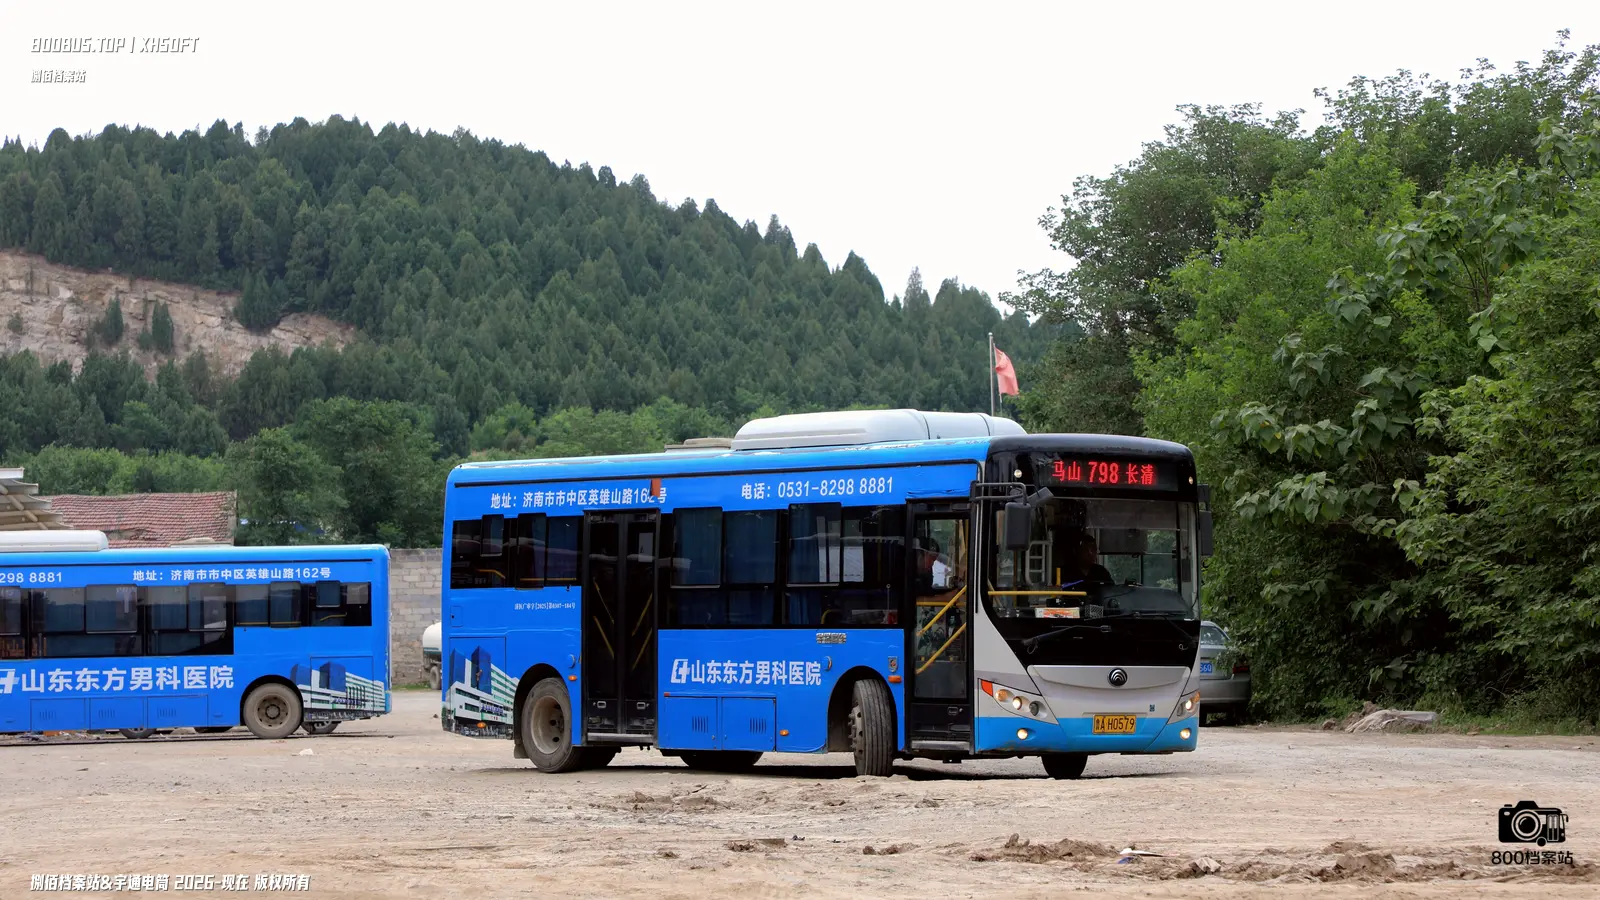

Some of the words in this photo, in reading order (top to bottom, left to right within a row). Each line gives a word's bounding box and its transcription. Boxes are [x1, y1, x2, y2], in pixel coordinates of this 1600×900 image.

[859, 476, 893, 494] 8881
[1052, 460, 1081, 482] 马山
[1088, 461, 1119, 484] 798
[1126, 463, 1155, 485] 长清
[29, 572, 62, 583] 8881
[21, 665, 234, 693] 山东东方男科医院
[690, 659, 822, 686] 山东东方男科医院
